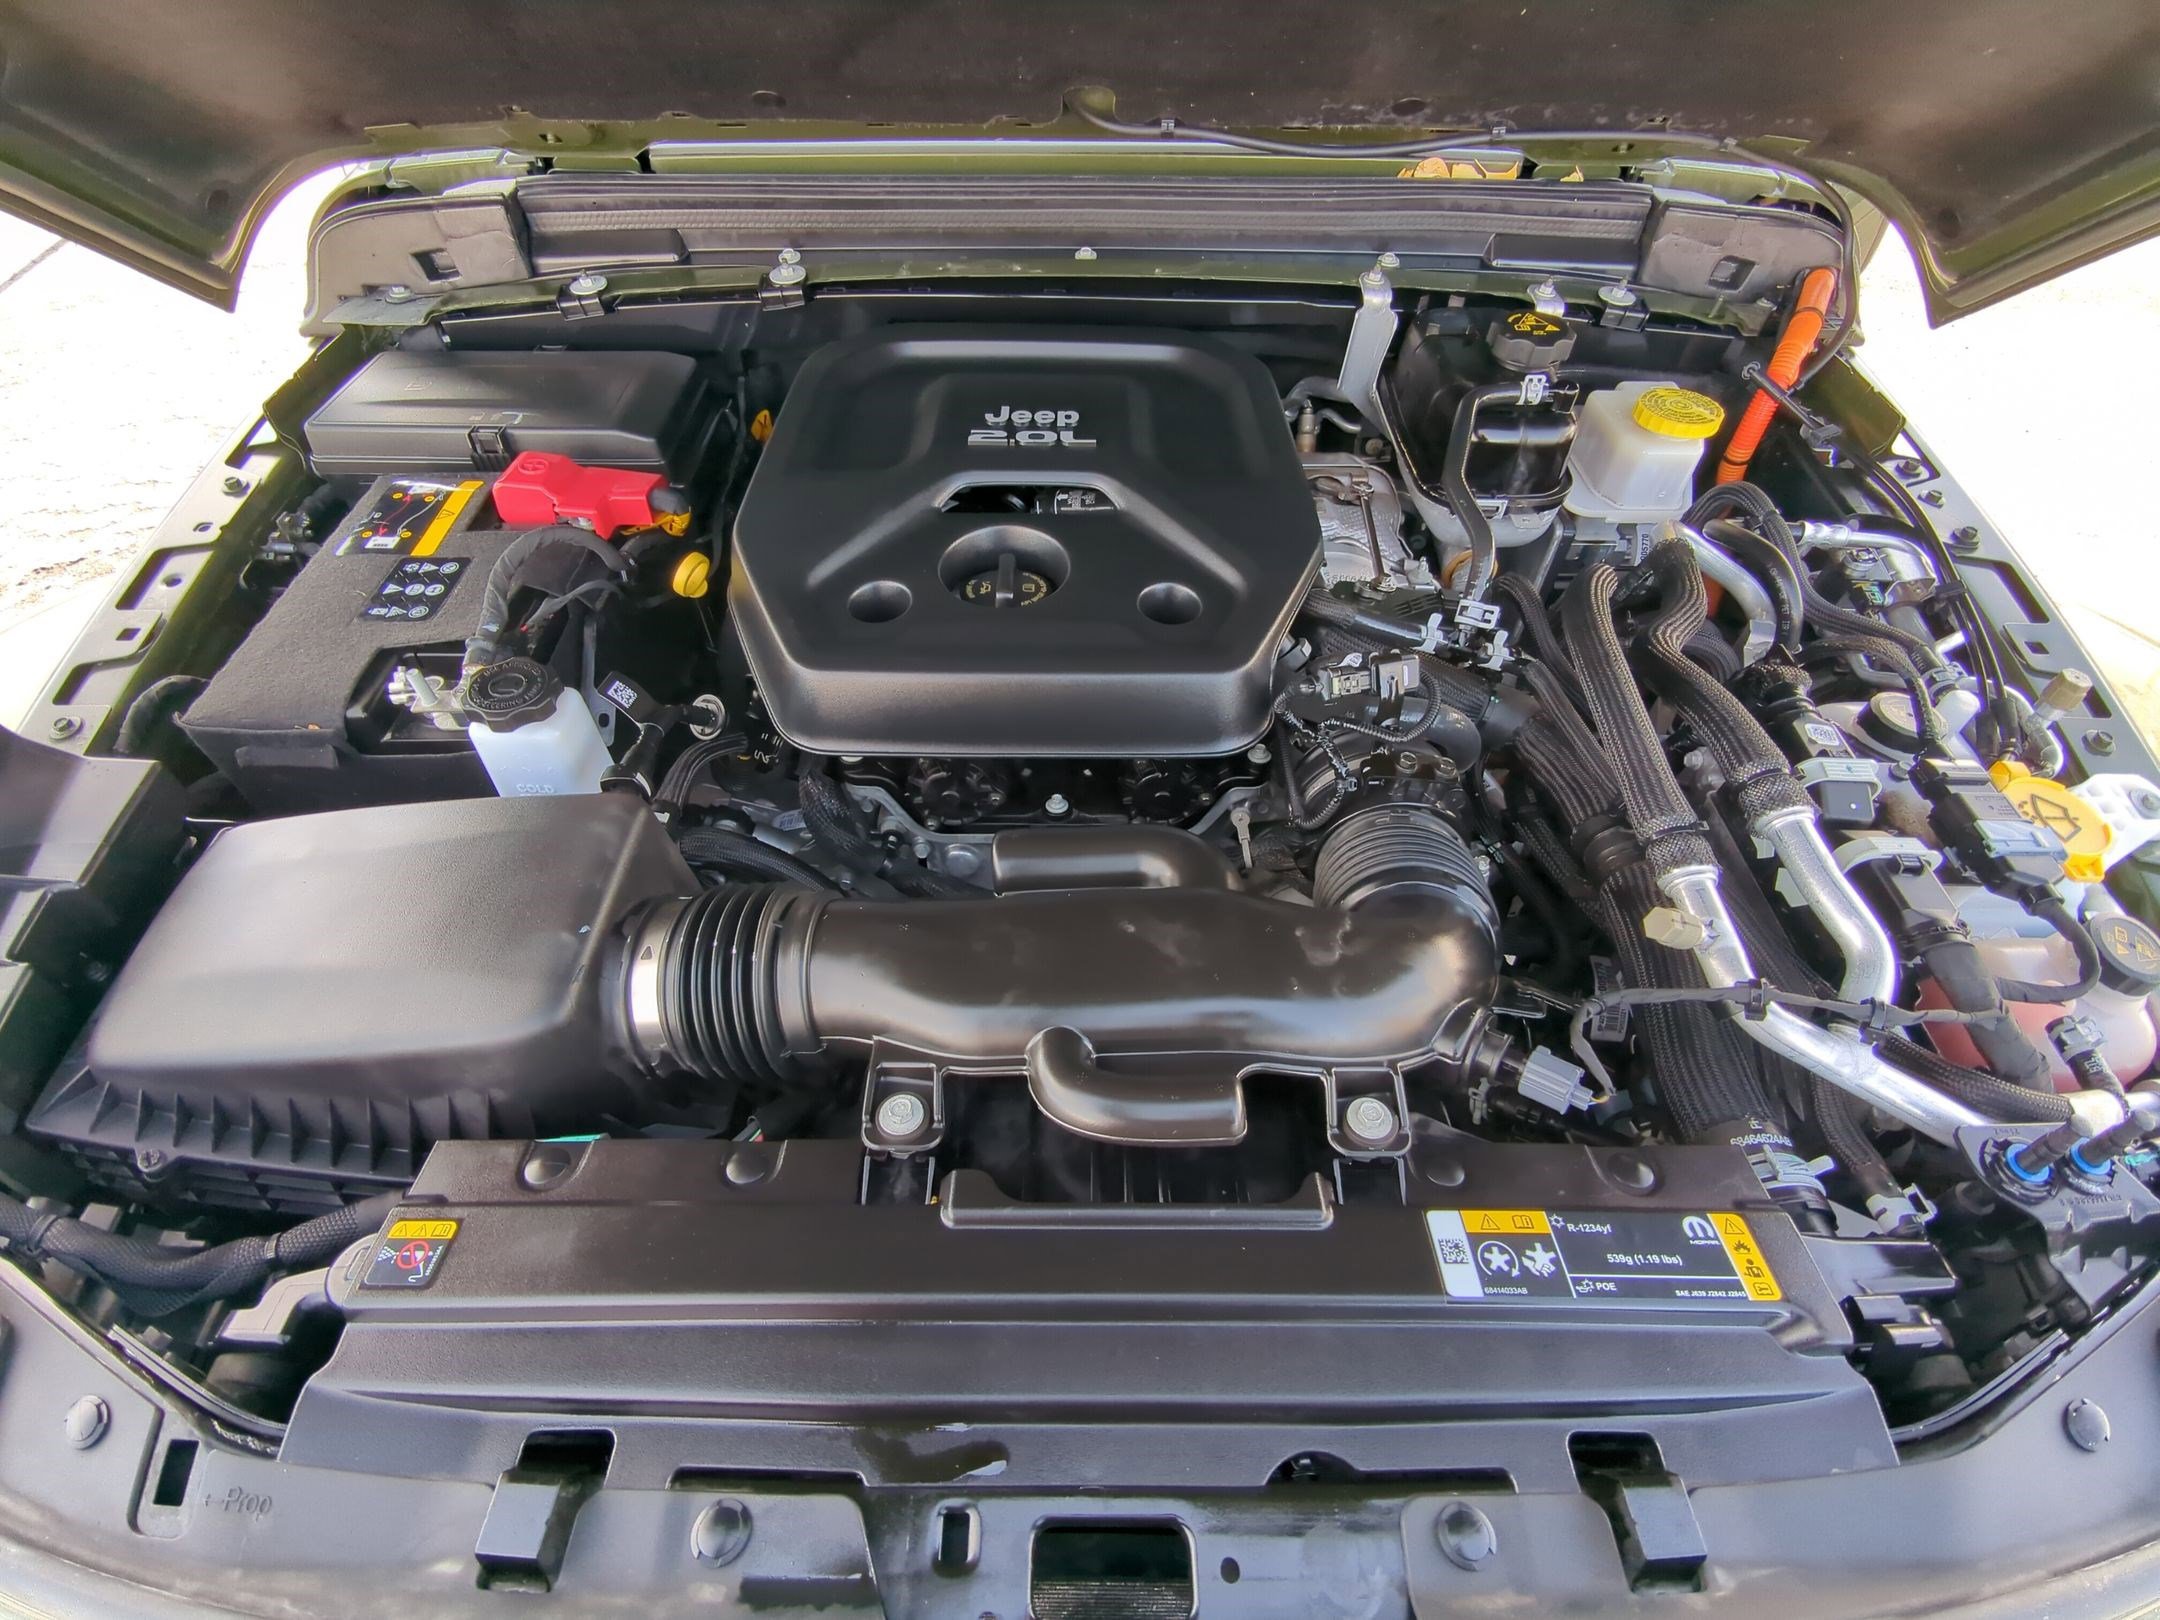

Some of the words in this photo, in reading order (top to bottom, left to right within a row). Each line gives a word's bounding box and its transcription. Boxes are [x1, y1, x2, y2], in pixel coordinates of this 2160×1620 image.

[984, 405, 1080, 427] Jeep
[967, 429, 1097, 446] 2.0L
[516, 783, 555, 793] COLD
[1566, 1223, 1612, 1235] R-1234yf
[1606, 1253, 1633, 1265] 539g
[1634, 1253, 1660, 1266] (1.19
[1661, 1254, 1683, 1267] lbs)
[1595, 1282, 1618, 1291] POE
[224, 1486, 273, 1522] Prop
